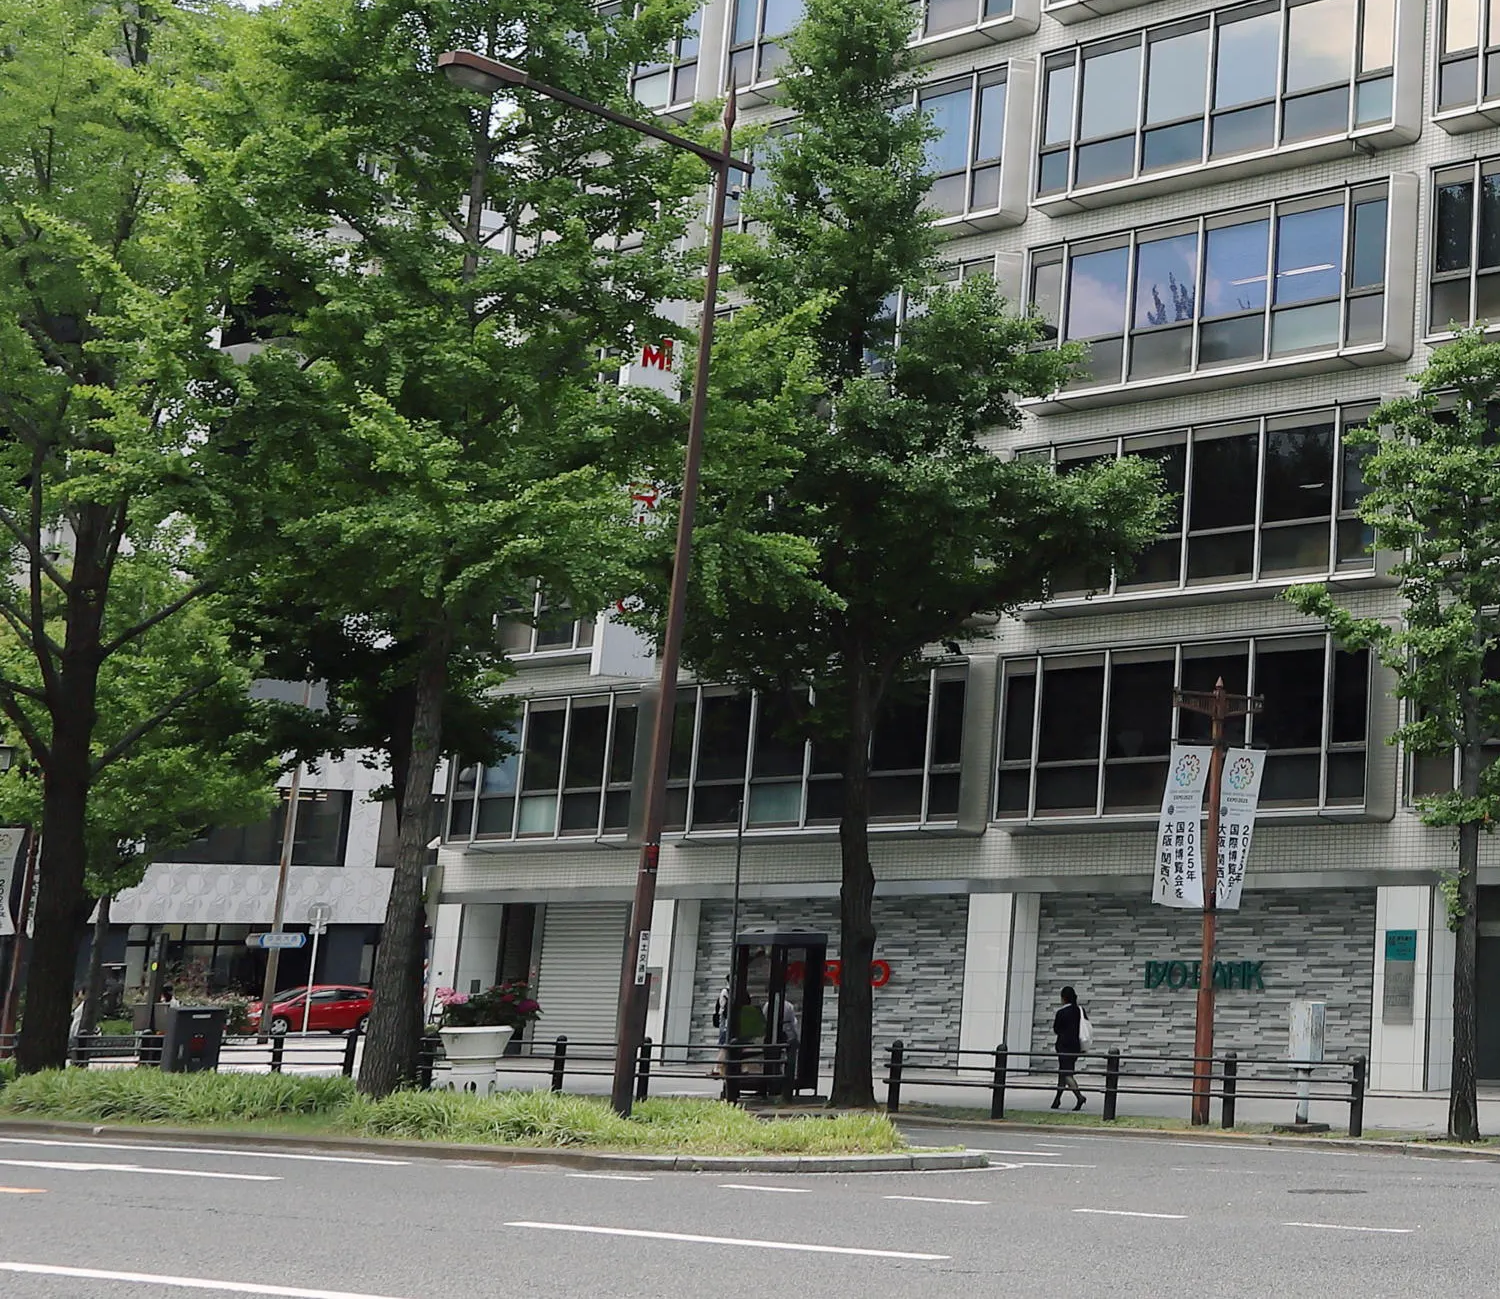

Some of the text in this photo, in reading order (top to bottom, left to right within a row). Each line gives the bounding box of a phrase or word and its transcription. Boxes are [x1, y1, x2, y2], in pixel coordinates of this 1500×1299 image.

[1174, 821, 1185, 899] 国際博覧会を
[1186, 821, 1197, 882] 2025年
[1143, 960, 1188, 990] IYO
